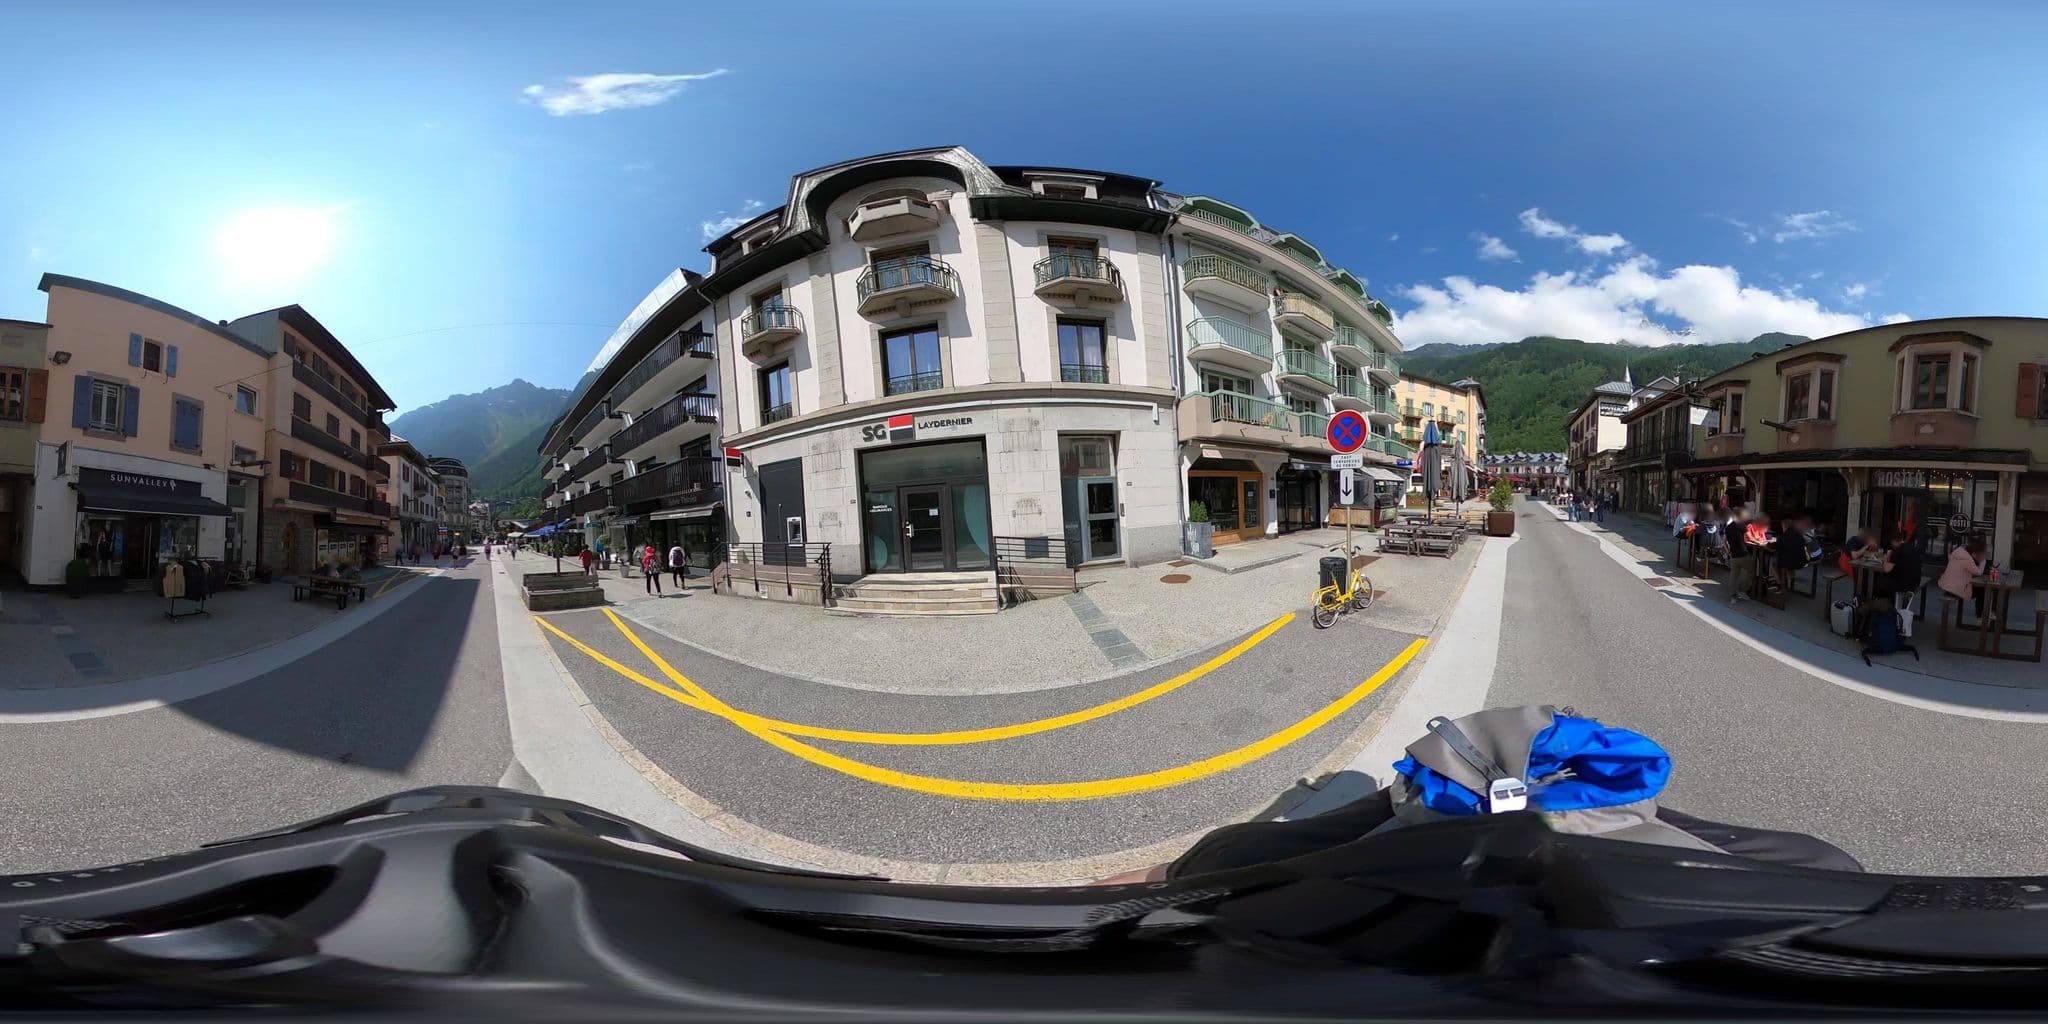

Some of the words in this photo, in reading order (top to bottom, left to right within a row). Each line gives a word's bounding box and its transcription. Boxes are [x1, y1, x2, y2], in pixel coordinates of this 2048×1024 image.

[862, 424, 888, 442] SG
[918, 417, 973, 430] LAYDERNIER
[110, 474, 168, 487] SUNVALLEY
